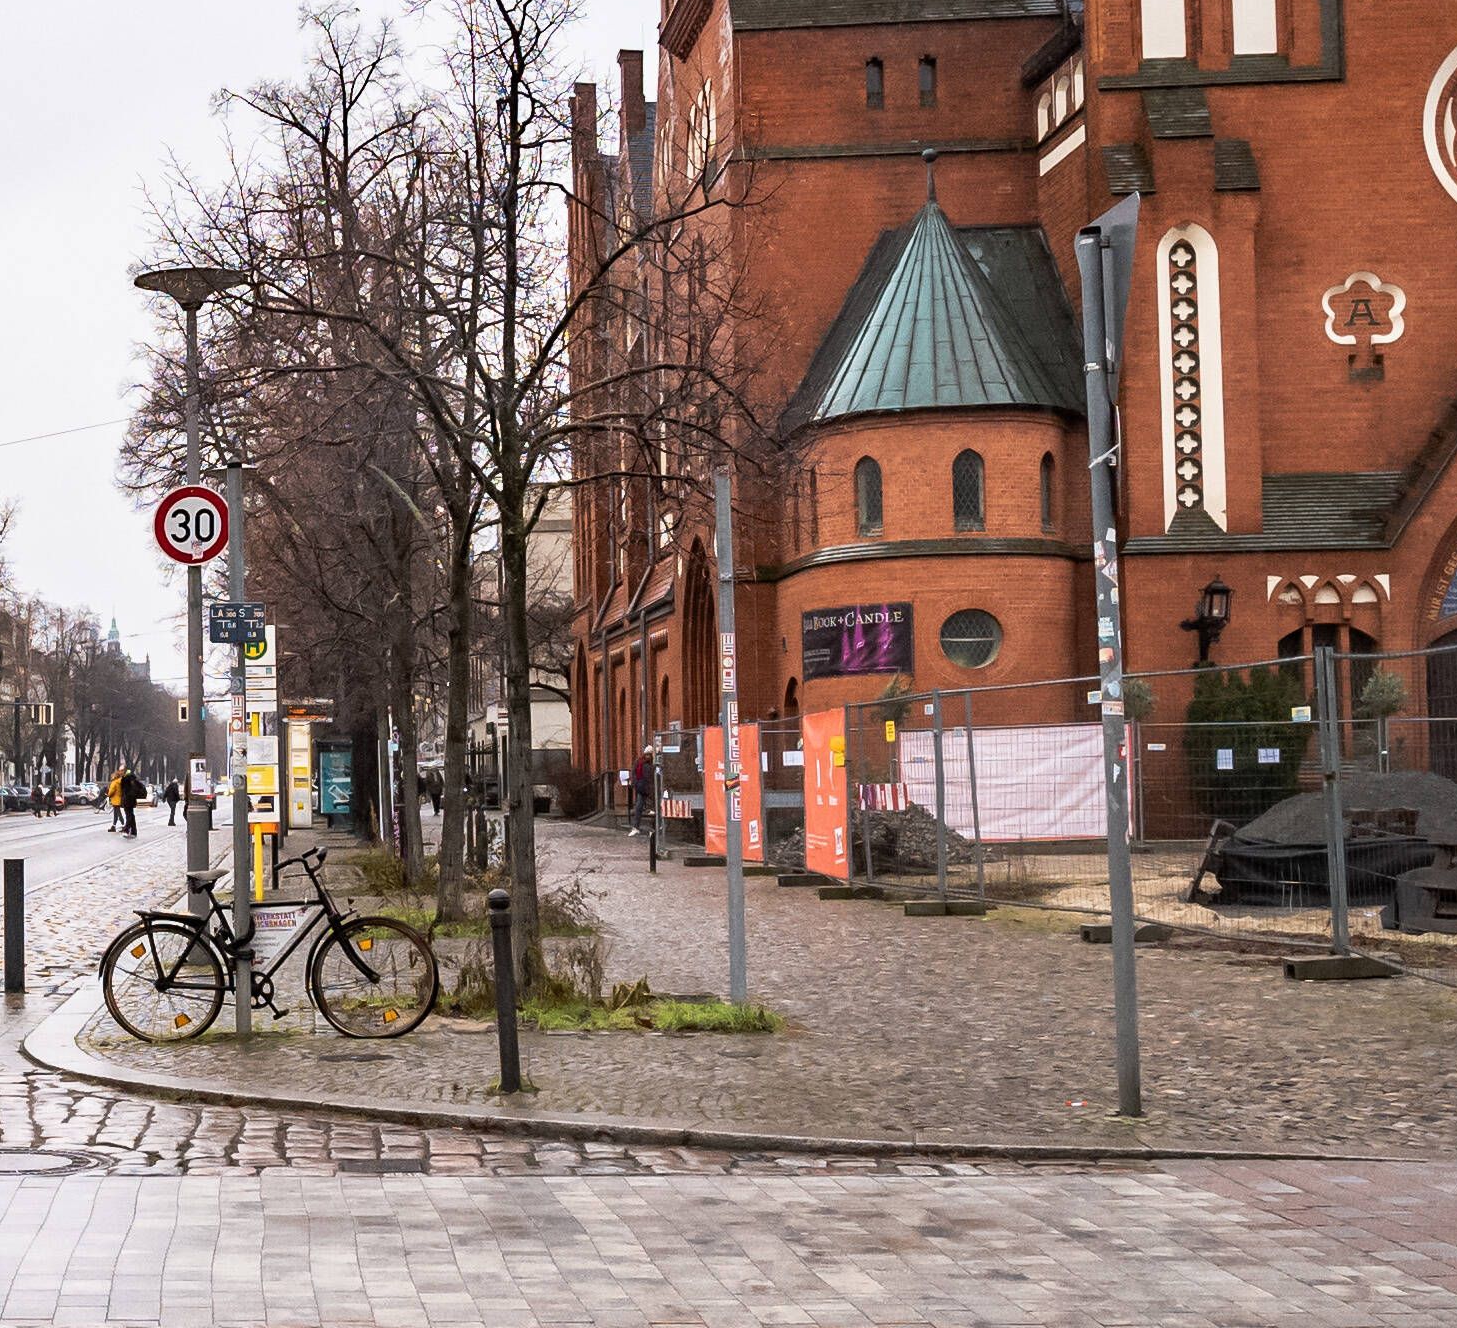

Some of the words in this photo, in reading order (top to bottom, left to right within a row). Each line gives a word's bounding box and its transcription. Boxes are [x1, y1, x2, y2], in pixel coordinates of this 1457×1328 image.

[170, 508, 215, 544] 30
[813, 616, 837, 630] BOOK
[844, 611, 904, 628] CANDLE
